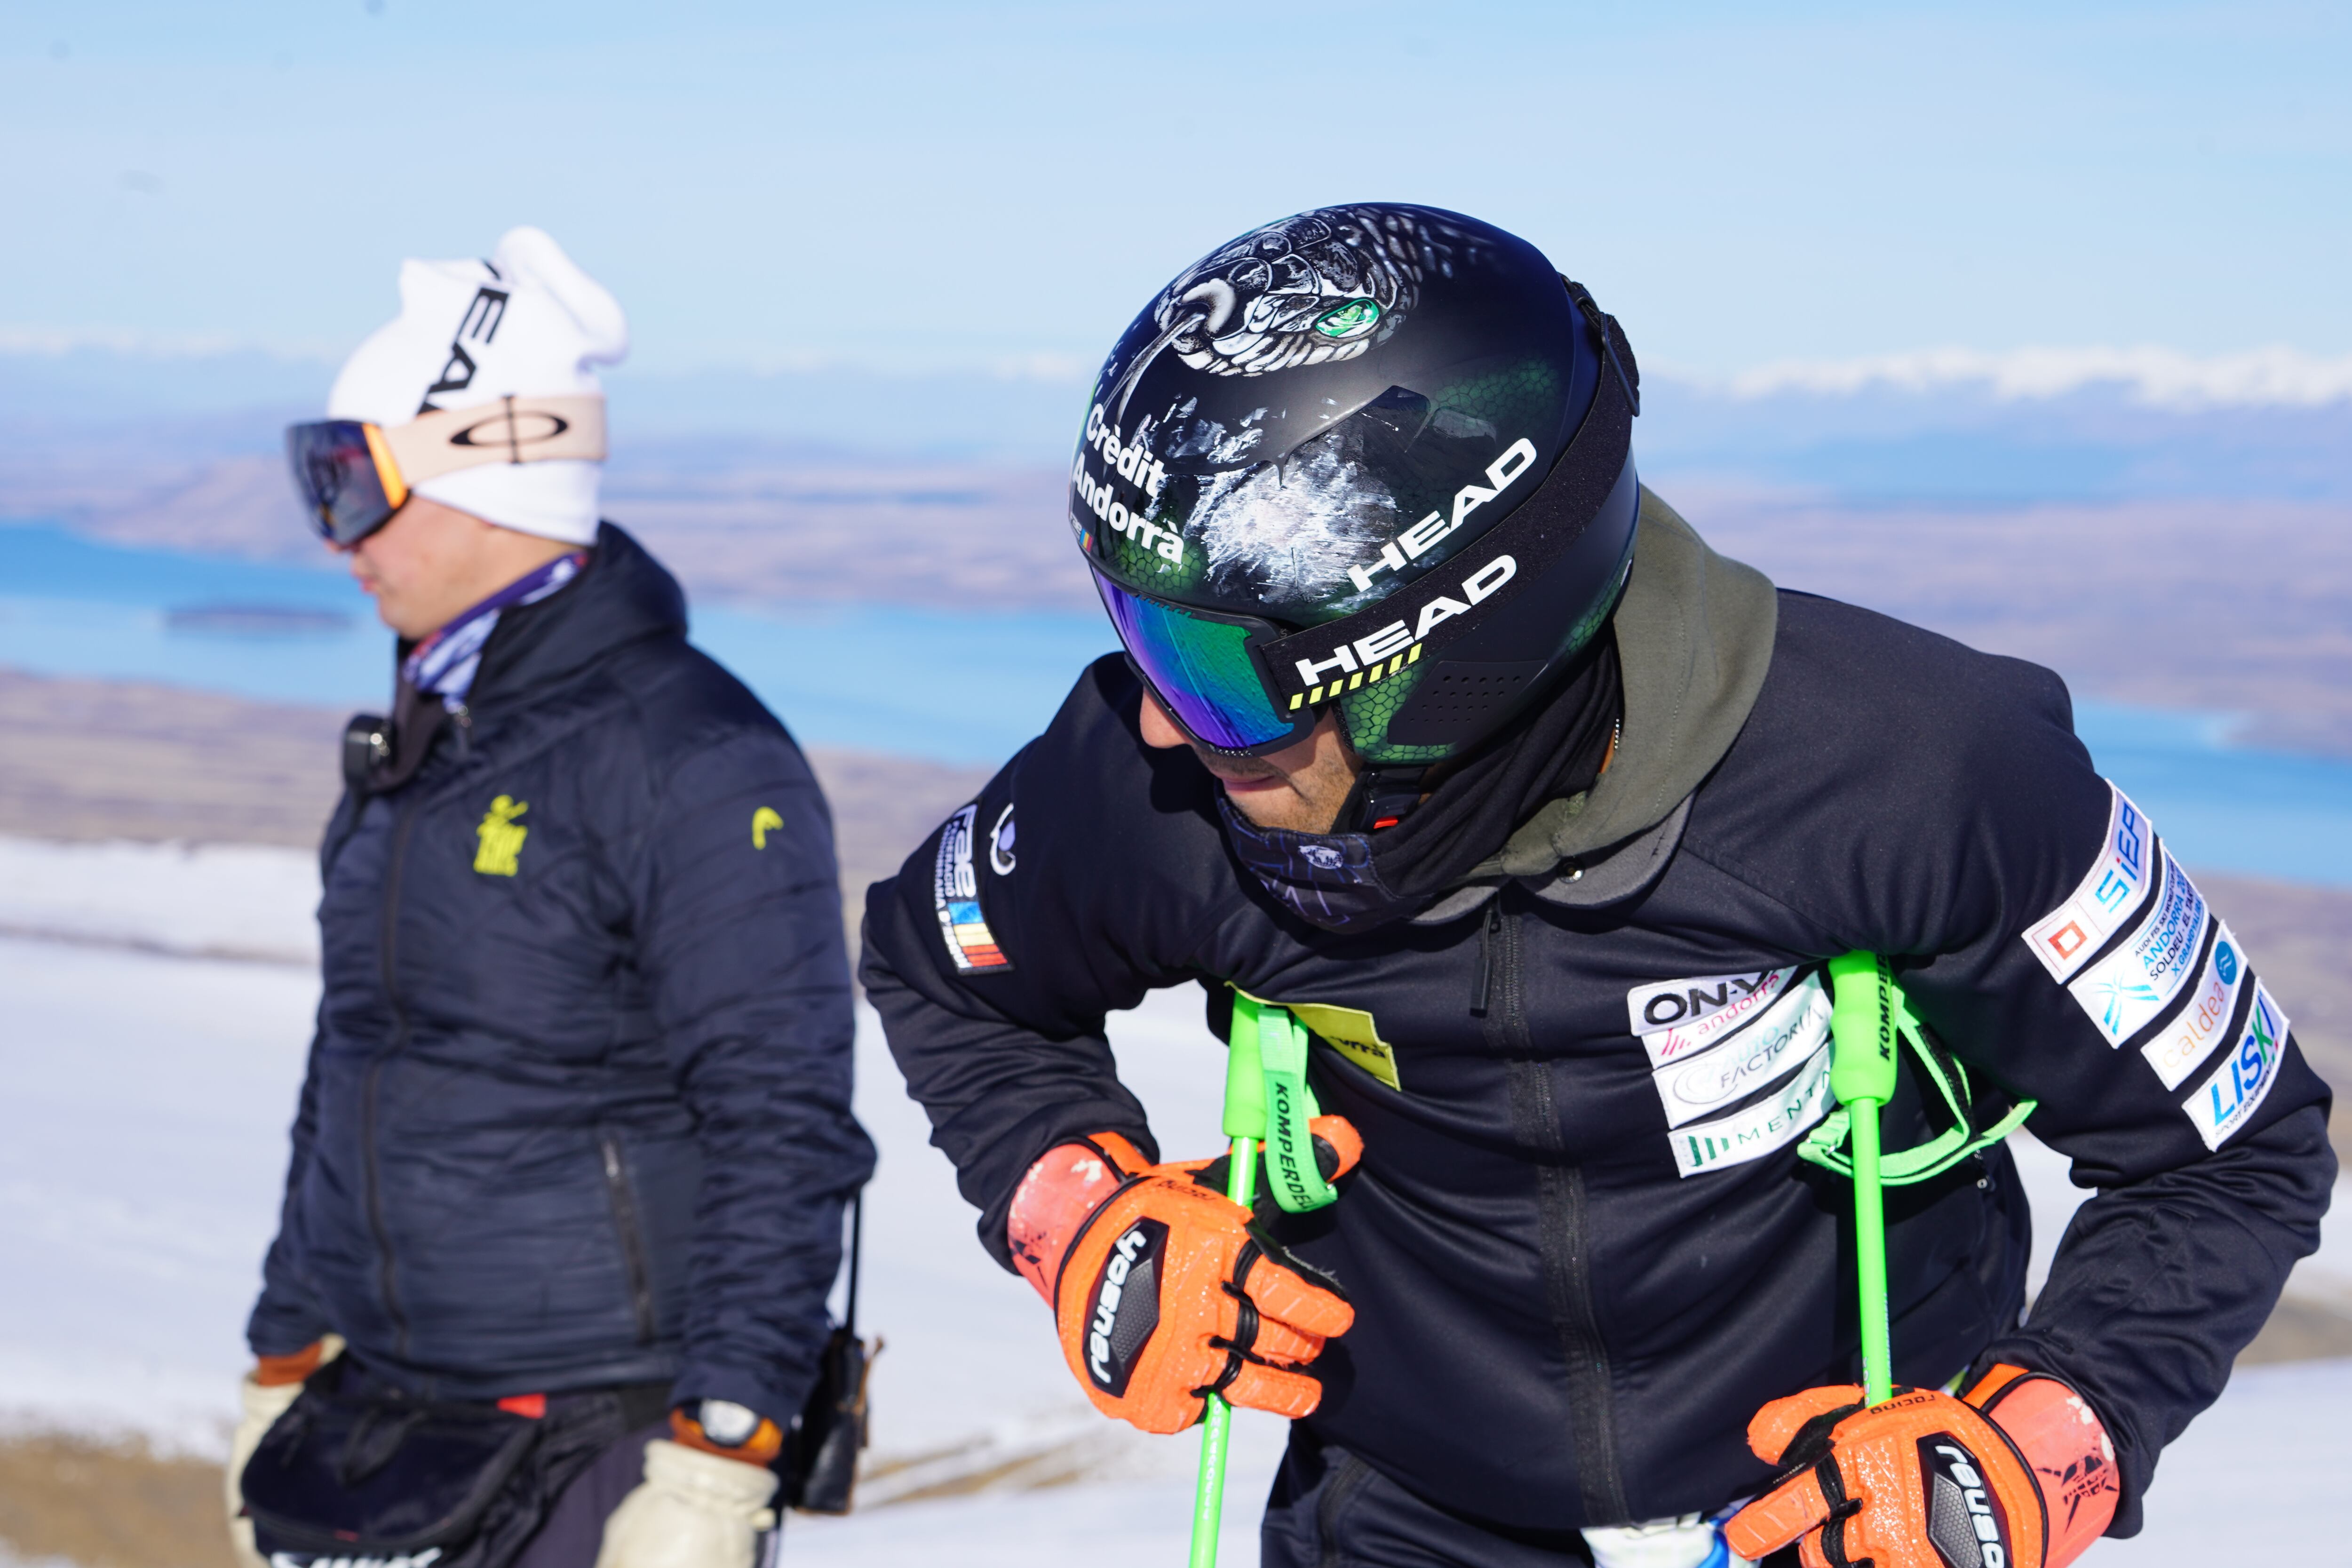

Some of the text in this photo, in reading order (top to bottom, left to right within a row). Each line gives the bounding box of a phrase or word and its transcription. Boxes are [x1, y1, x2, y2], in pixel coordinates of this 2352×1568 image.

[416, 259, 509, 417] EA
[1086, 403, 1165, 497] Crèdit
[1073, 452, 1184, 564] Andorrà
[1346, 438, 1537, 592] HEAD
[1295, 554, 1517, 686] HEAD
[2135, 937, 2152, 957] AUDI
[2150, 927, 2161, 939] FIS
[2159, 913, 2167, 927] SKI
[2143, 895, 2184, 970] ANDORRA
[2150, 931, 2184, 981] SOLDEU
[2182, 912, 2191, 926] EL
[2164, 981, 2224, 1068] caldea
[2211, 995, 2275, 1127] LISKI
[1089, 1230, 1147, 1383] reusch
[1870, 1394, 1936, 1414] racing
